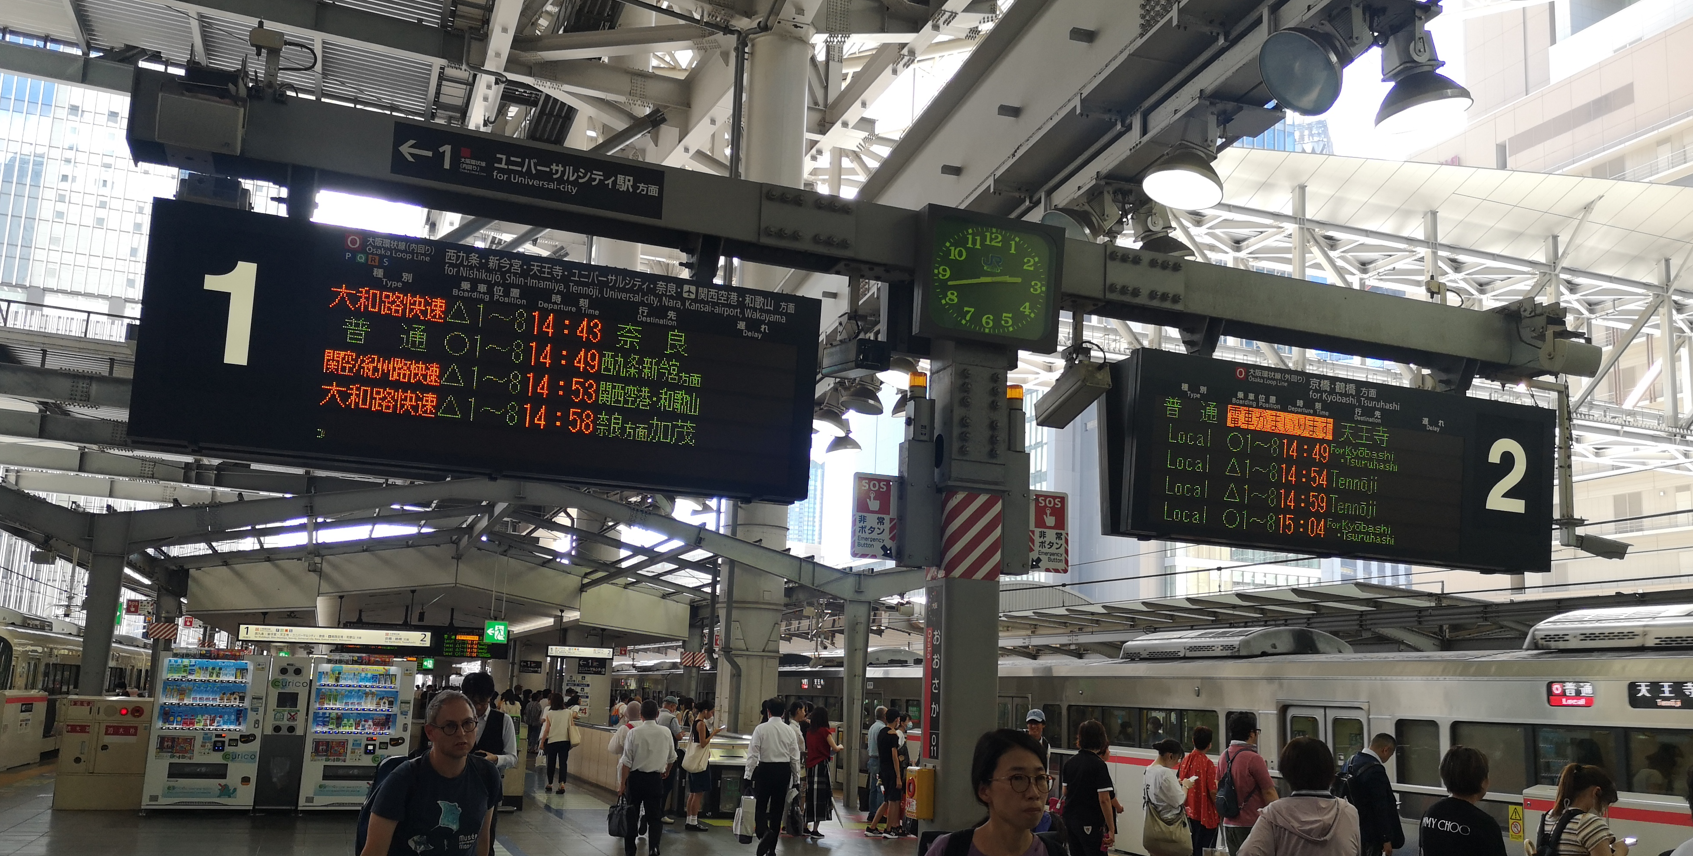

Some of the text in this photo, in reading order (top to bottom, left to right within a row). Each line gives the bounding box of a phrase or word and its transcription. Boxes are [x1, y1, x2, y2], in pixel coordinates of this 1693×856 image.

[438, 144, 452, 170] 1
[494, 153, 660, 197] ユニバーサルシティ駅 方面
[493, 170, 508, 181] for
[510, 173, 578, 195] Universal-city
[347, 235, 360, 248] O
[966, 234, 982, 249] 11
[984, 232, 1003, 247] 12
[948, 246, 967, 261] 10
[1009, 240, 1017, 254] 1
[345, 252, 352, 260] P
[370, 256, 377, 264] R
[383, 258, 389, 266] S
[393, 250, 412, 260] Loop
[413, 253, 431, 263] Line
[1023, 257, 1035, 271] 2
[938, 265, 951, 280] 9
[382, 278, 403, 289] Type
[1030, 280, 1042, 294] 3
[444, 264, 458, 276] for
[505, 275, 567, 293] Shin-Imamiya,
[603, 287, 661, 307] Universal-city,
[662, 297, 684, 310] Nara,
[685, 299, 743, 318] Kansai-airport,
[744, 308, 786, 324] Wakayama
[452, 288, 527, 306] Boarding Position
[945, 290, 958, 304] 8
[203, 260, 258, 366] 1
[329, 284, 447, 323] 大和路快速
[532, 310, 602, 343] 14:43
[538, 300, 600, 317] Departure Time
[779, 301, 796, 314] 方面
[963, 306, 975, 321] 7
[1019, 301, 1032, 315] 4
[637, 315, 677, 327] Destination
[981, 314, 994, 328] 6
[1001, 312, 1013, 327] 5
[742, 329, 763, 340] Delay
[529, 340, 600, 373] 14:49
[526, 371, 597, 404] 14:53
[1264, 378, 1277, 386] Loop
[1187, 391, 1201, 399] Type
[1360, 386, 1377, 398] 方面
[319, 381, 438, 418] 大和路快速
[523, 403, 594, 435] 14:58
[1232, 398, 1281, 410] Boarding Position
[1309, 390, 1321, 400] for
[1360, 397, 1401, 412] Tsuruhashi
[1288, 405, 1329, 417] Departure Time
[1226, 404, 1334, 440] 電車がまいります
[1338, 422, 1390, 447] 天王寺
[1354, 414, 1382, 424] Destination
[1426, 424, 1441, 433] Delay
[1168, 423, 1212, 447] Local
[1281, 438, 1330, 463] 14:49
[1166, 449, 1210, 473] Local
[1280, 463, 1328, 488] 14:54
[1485, 437, 1527, 514] 2
[862, 480, 887, 492] SOS
[1165, 475, 1209, 499] Local
[1279, 488, 1327, 513] 14:59
[1038, 497, 1062, 508] SOS
[858, 514, 886, 526] 非常
[1163, 501, 1207, 525] Local
[1278, 514, 1326, 538] 15:04
[858, 525, 885, 536] ボタン
[1038, 530, 1063, 541] 非常
[857, 535, 886, 544] Emergency
[857, 541, 875, 549] Button
[1038, 540, 1063, 550] ボタン
[1038, 549, 1063, 558] Emergency
[1047, 556, 1063, 564] Button
[244, 626, 250, 636] 1
[420, 633, 427, 642] 2
[930, 630, 941, 718] おおさか
[273, 679, 308, 690] curico
[1563, 682, 1595, 697] 普通
[1561, 697, 1586, 705] Local
[930, 746, 937, 757] 11
[1437, 819, 1471, 836] CHOO
